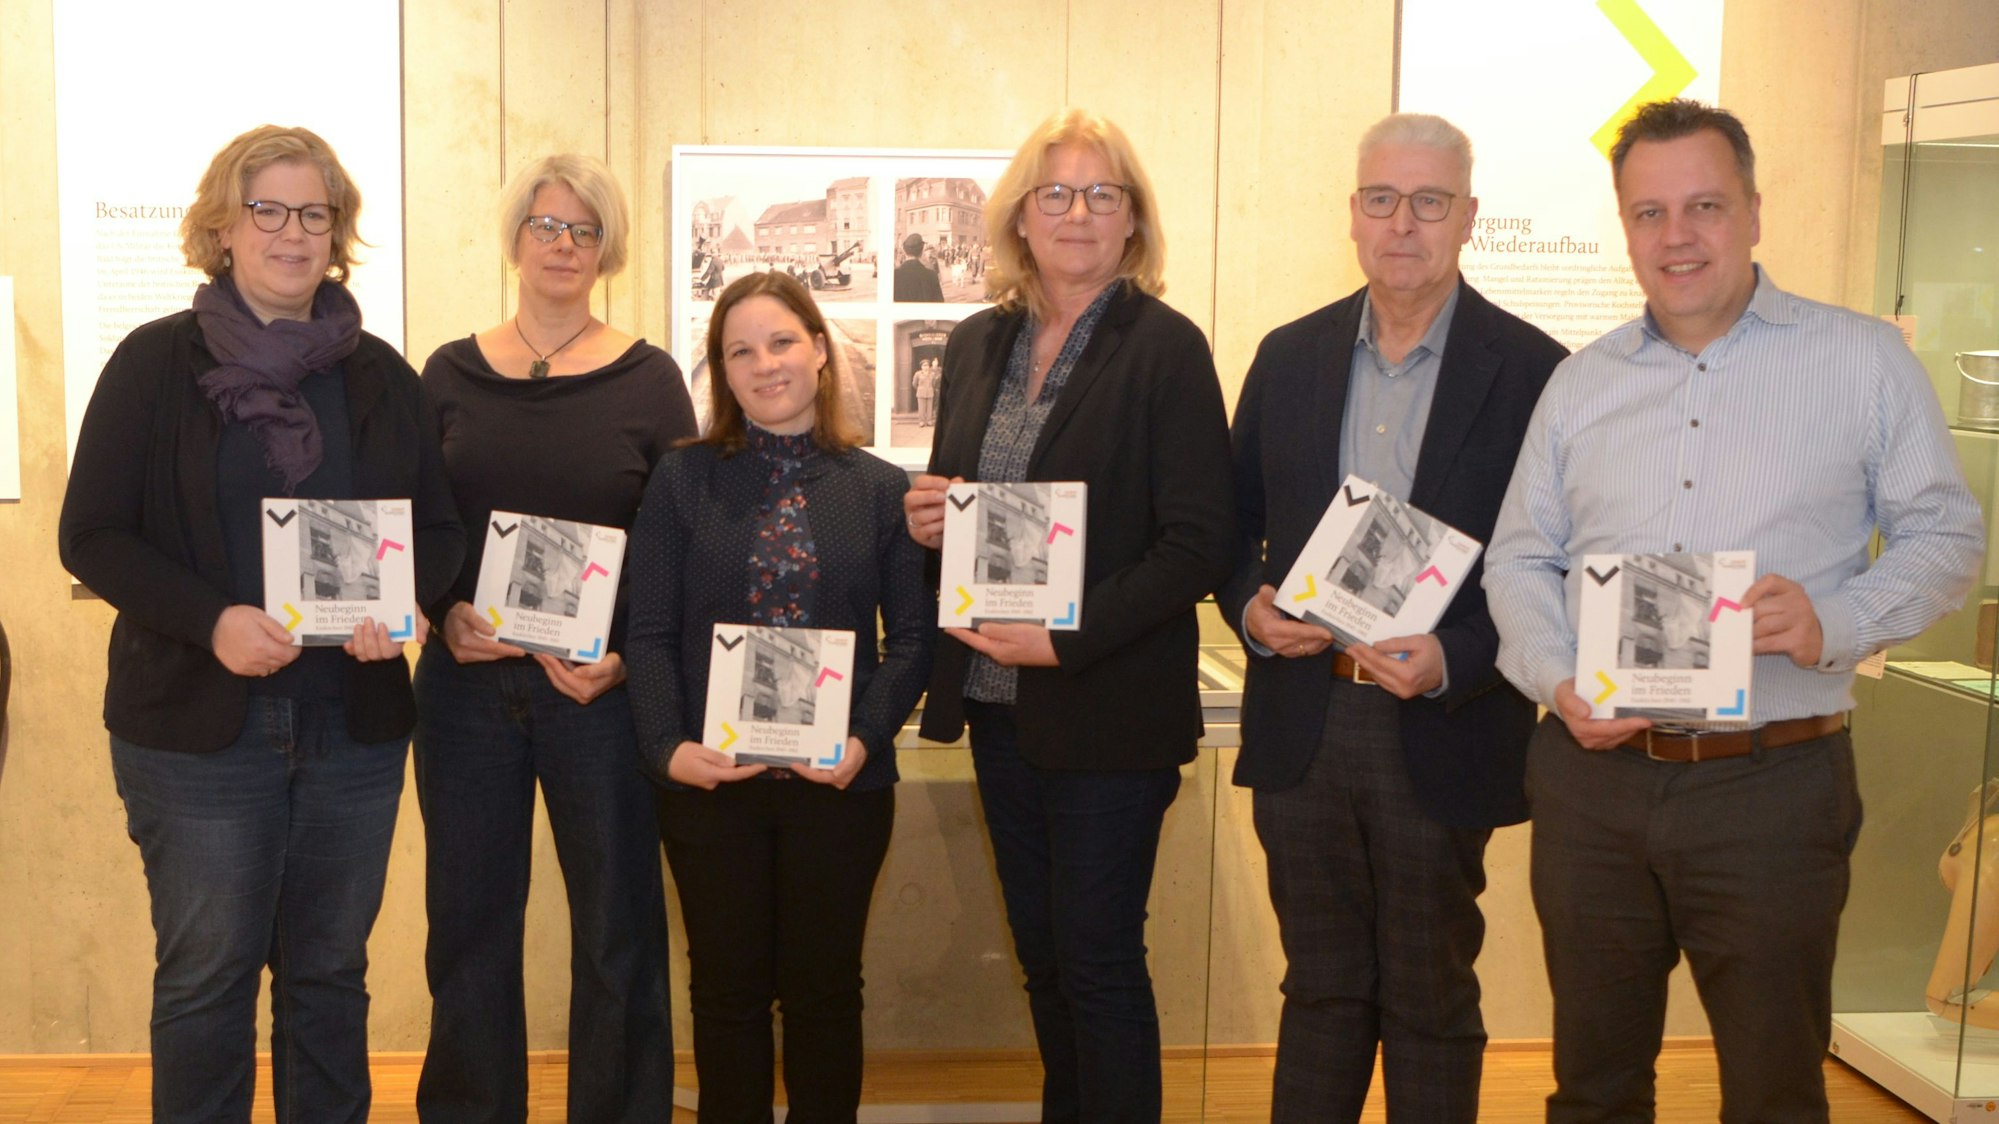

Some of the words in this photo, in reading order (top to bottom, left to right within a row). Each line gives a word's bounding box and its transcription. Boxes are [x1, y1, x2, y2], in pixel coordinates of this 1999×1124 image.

[1471, 217, 1532, 235] orgung
[1470, 235, 1599, 254] Wiederaufbau
[1609, 264, 1634, 273] Aufgab
[986, 587, 1034, 599] Neubeginn
[985, 598, 997, 607] im
[1000, 598, 1033, 607] Frieden
[1330, 590, 1378, 622] Neubeginn
[315, 604, 367, 615] Neubeginn
[1325, 599, 1337, 611] im
[1338, 606, 1371, 631] Frieden
[315, 614, 328, 623] im
[516, 611, 562, 627] Neubeginn
[514, 622, 525, 631] im
[528, 623, 560, 636] Frieden
[1632, 673, 1692, 686] Neubeginn
[1631, 685, 1646, 695] im
[1649, 685, 1691, 695] Frieden
[751, 724, 800, 737] Neubeginn
[750, 735, 761, 743] im
[765, 735, 799, 746] Frieden
